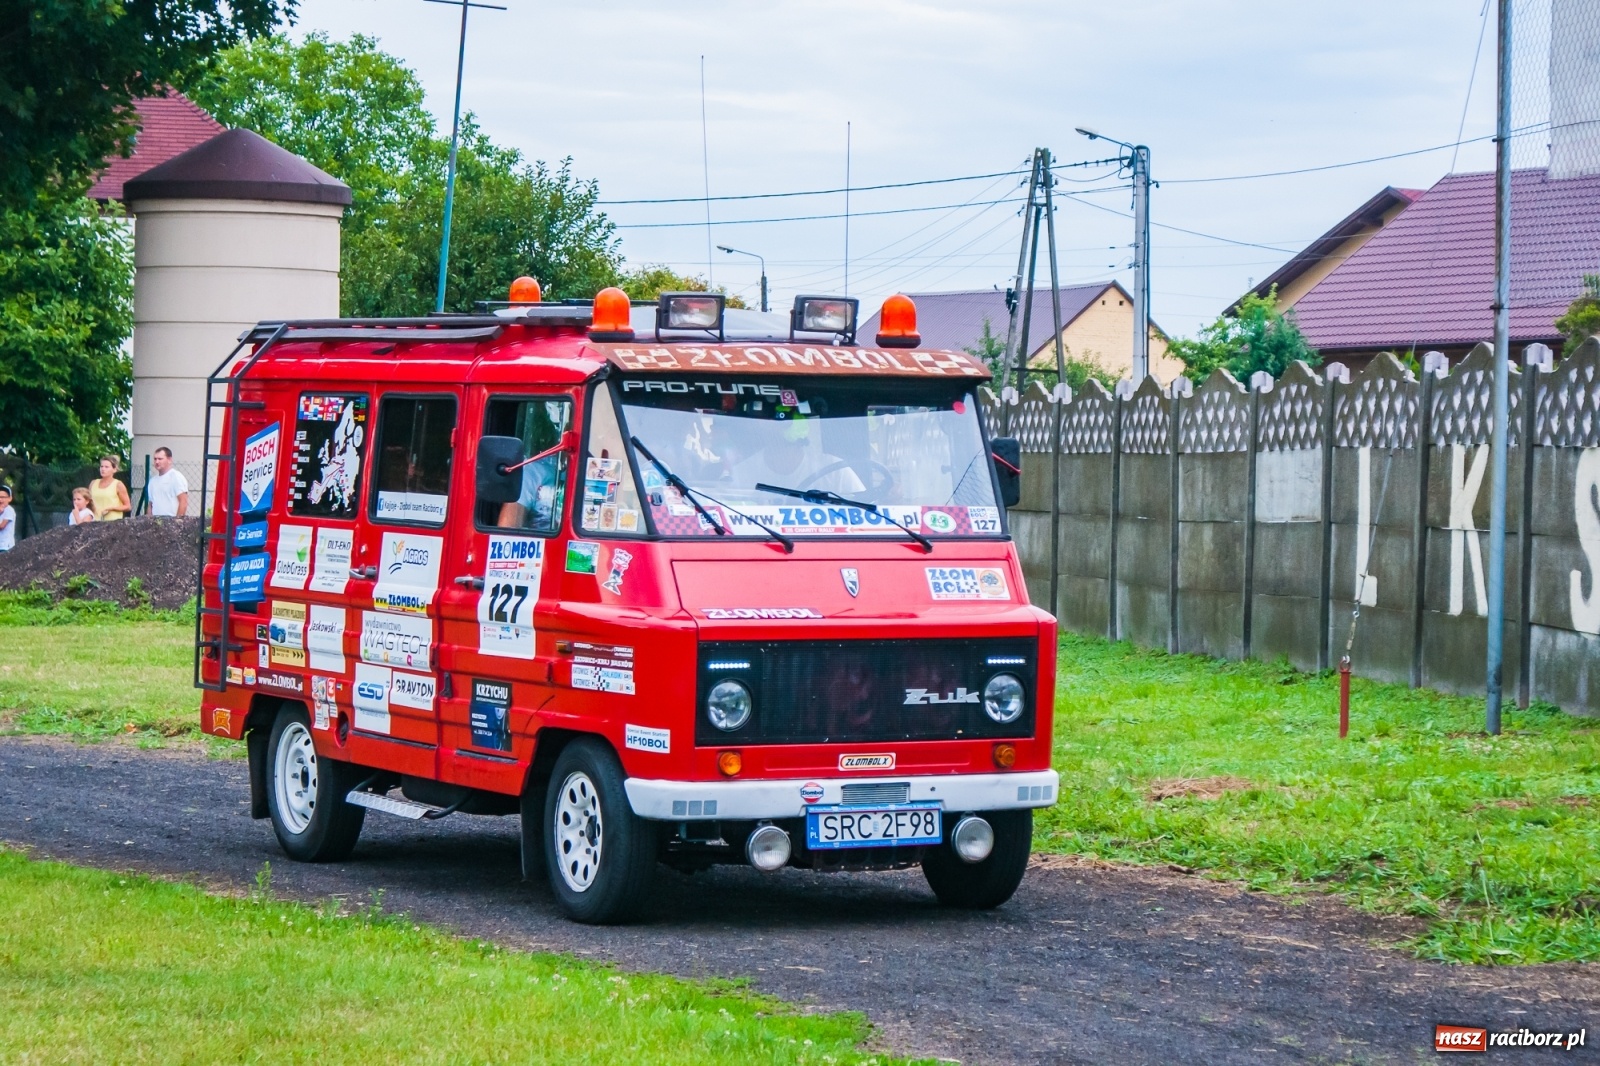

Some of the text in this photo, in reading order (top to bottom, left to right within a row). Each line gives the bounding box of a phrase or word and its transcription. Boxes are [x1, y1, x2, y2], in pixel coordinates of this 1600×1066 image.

[622, 380, 781, 396] PRO-TUNE
[245, 437, 276, 466] BOSCH
[243, 462, 274, 484] Service
[238, 528, 263, 540] Car Service
[974, 519, 997, 531] 127
[403, 547, 429, 566] AGROS
[489, 541, 542, 560] ZŁOMBOL
[277, 560, 307, 576] GlobGrass
[488, 583, 529, 624] 127
[363, 629, 431, 656] WAGTECH
[476, 683, 509, 700] KRZYCHU
[626, 735, 669, 749] HF10BOL
[810, 831, 819, 839] PL
[823, 811, 935, 841] SRC 2F98
